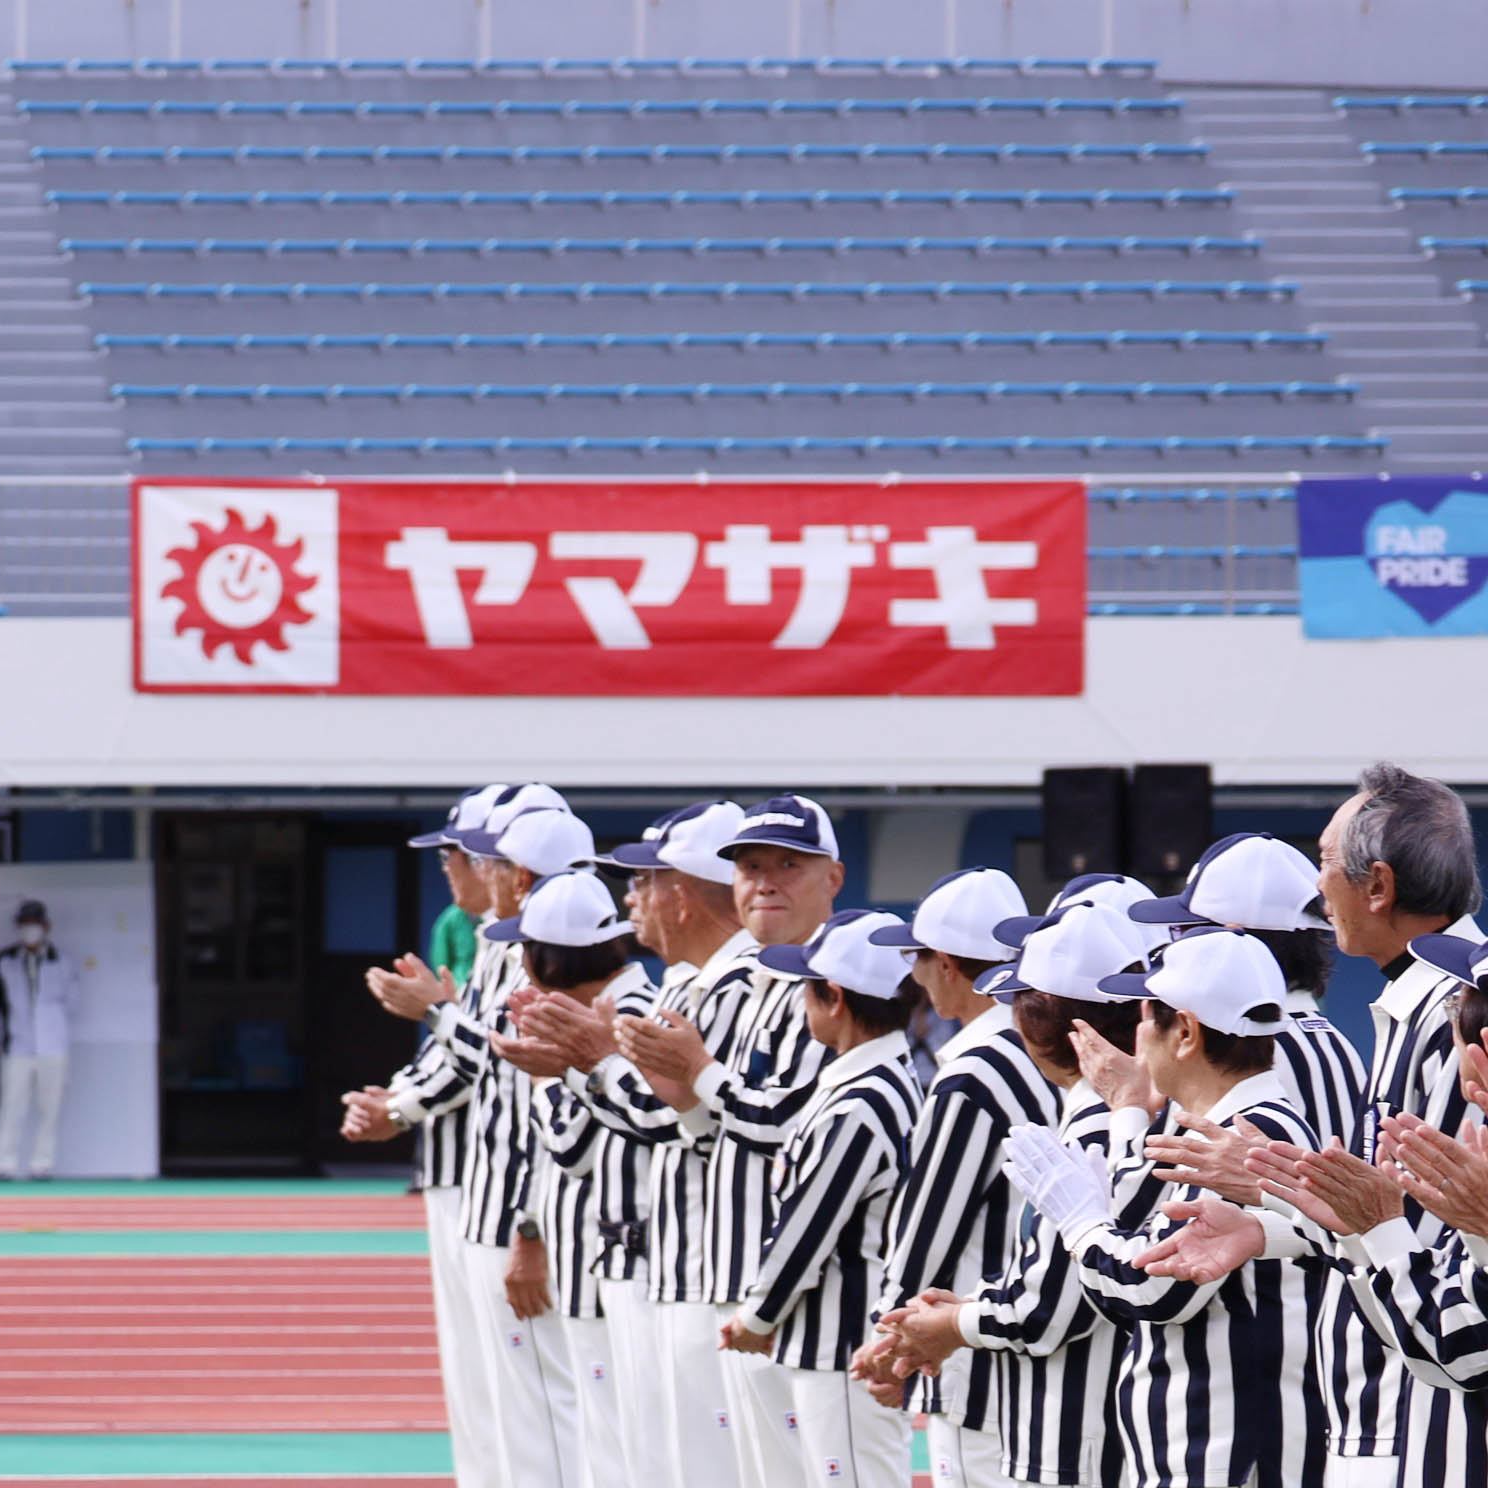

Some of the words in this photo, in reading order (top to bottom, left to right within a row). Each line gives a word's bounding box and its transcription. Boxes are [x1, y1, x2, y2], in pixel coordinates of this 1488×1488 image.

[1376, 525, 1448, 555] FAIR
[384, 524, 1038, 650] ヤマザキ
[1377, 557, 1470, 587] PRIDE
